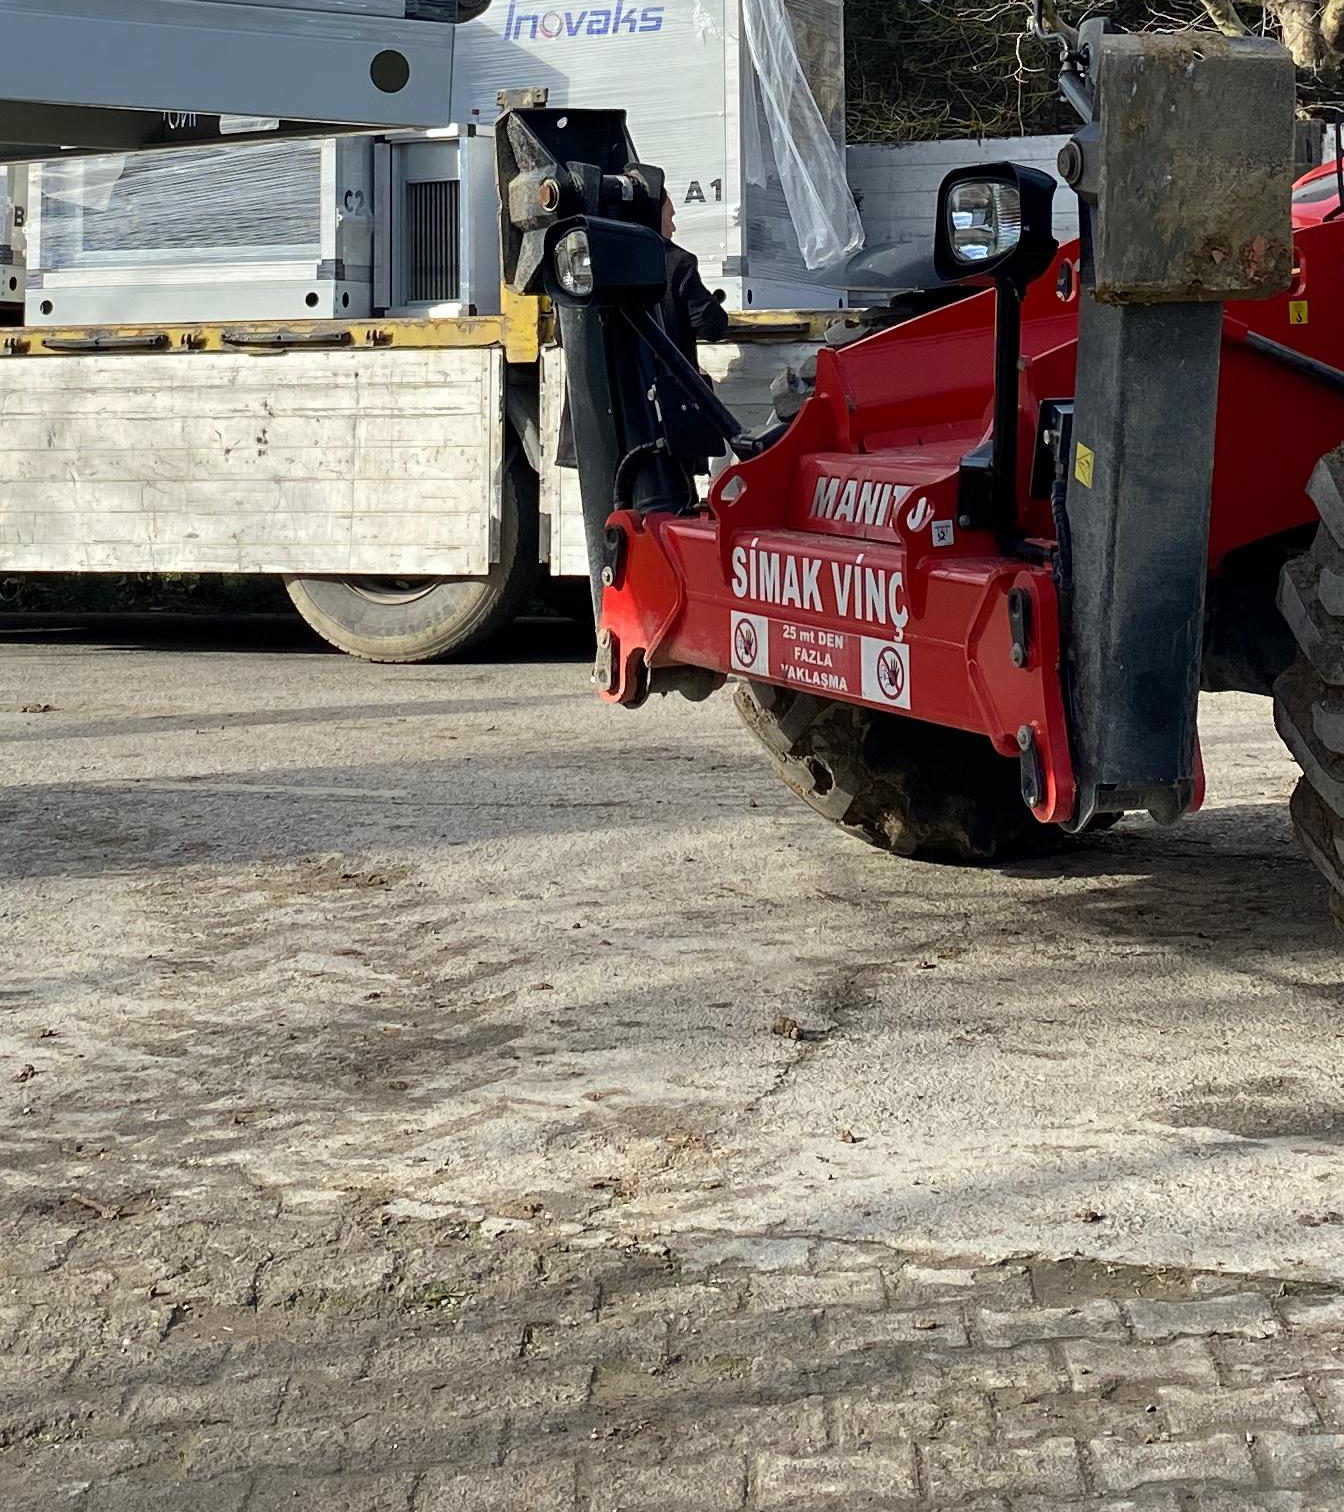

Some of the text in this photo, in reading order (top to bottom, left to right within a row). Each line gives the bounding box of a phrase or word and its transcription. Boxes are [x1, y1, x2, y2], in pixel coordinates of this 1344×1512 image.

[683, 178, 723, 204] A1
[782, 624, 844, 648] 25 mt DEN
[794, 647, 833, 668] FAZLA
